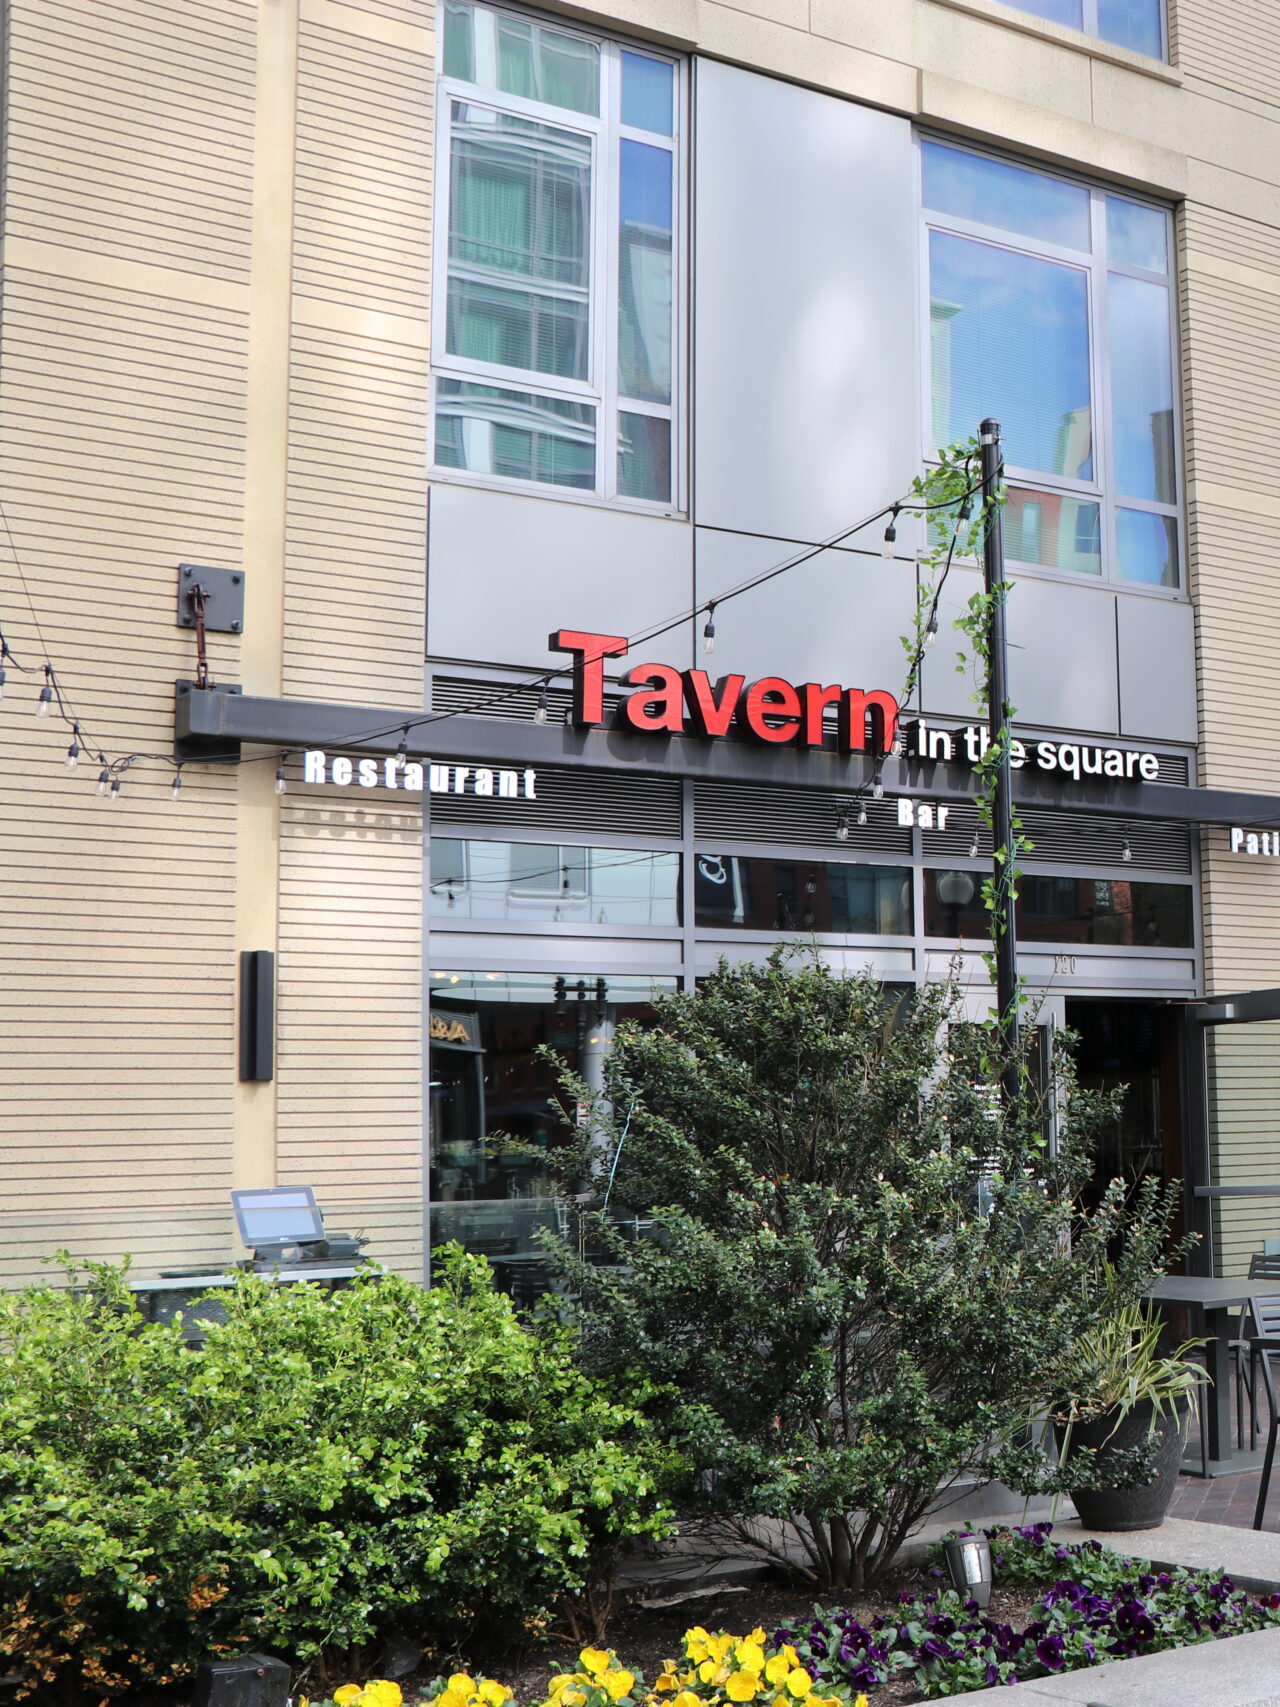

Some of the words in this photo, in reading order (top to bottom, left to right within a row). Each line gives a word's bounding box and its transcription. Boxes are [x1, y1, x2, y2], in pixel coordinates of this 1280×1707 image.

[549, 629, 899, 753] Tavern
[304, 750, 537, 799] Restaurant
[918, 719, 951, 760] in
[1037, 741, 1160, 781] square
[897, 798, 949, 830] Bar
